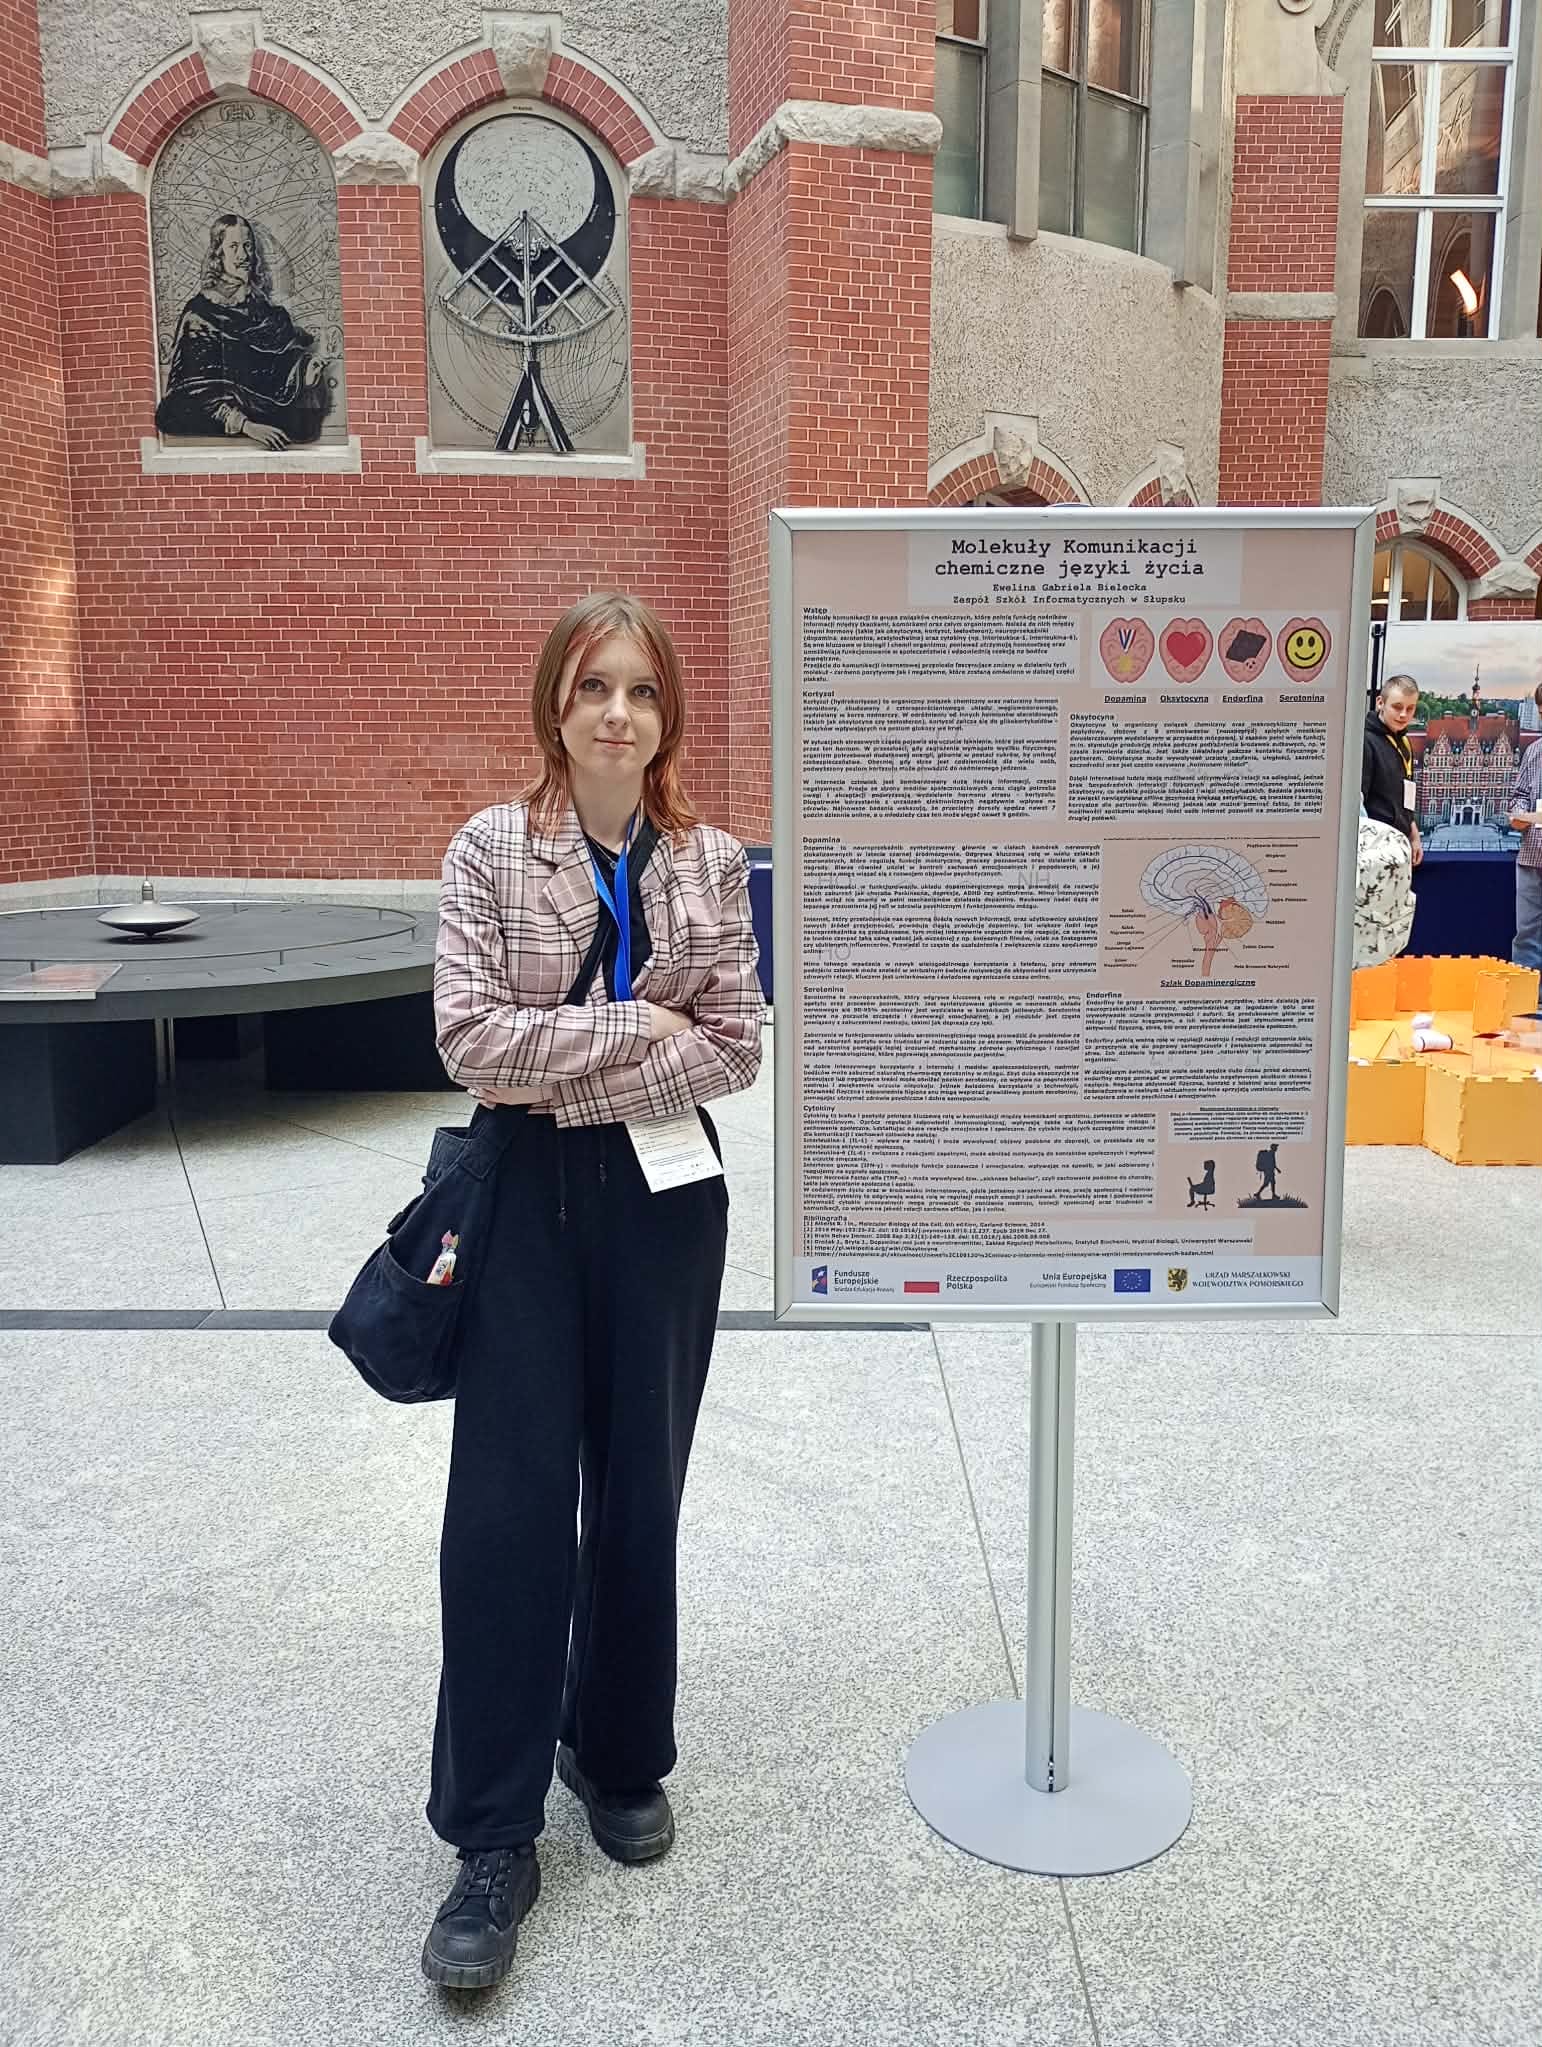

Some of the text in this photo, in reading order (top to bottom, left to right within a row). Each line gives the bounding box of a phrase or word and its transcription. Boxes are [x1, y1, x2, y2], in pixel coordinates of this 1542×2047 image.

[952, 540, 1197, 557] Molekuły Komunikacji
[935, 562, 1204, 578] chemiczne języki życia
[952, 596, 990, 605] Zespół
[1033, 596, 1126, 605] Informatycznych
[1143, 596, 1186, 605] Słupsku
[1104, 695, 1147, 703] Dopamina
[1160, 695, 1209, 703] Oksytocyna
[802, 836, 841, 844] Dopamina
[803, 1104, 836, 1112] Cytokiny
[946, 1275, 1008, 1283] Rzeczpospolita
[1062, 1273, 1107, 1281] Europejska
